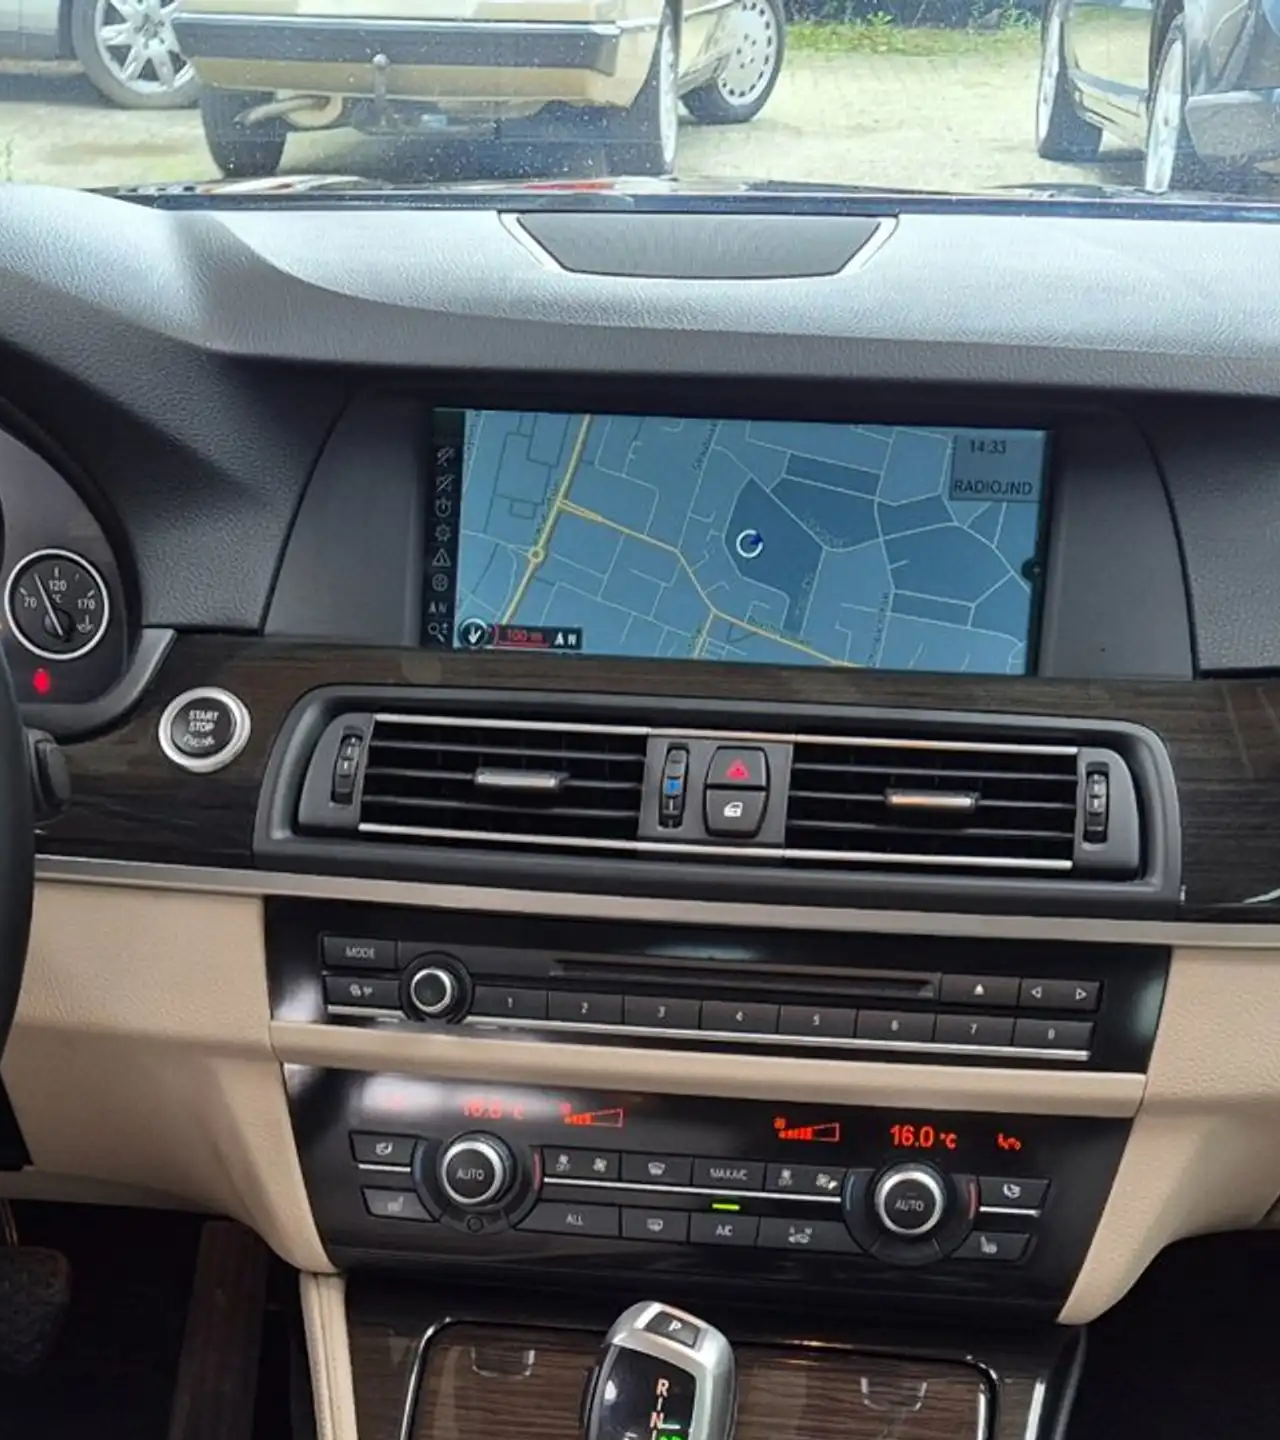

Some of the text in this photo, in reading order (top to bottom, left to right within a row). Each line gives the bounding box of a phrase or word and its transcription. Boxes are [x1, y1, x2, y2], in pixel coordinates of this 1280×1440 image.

[188, 709, 219, 721] START
[189, 721, 216, 732] STOP
[345, 946, 376, 960] MODE
[506, 997, 513, 1008] 1
[580, 1002, 588, 1014] 2
[658, 1007, 665, 1018] 3
[736, 1010, 744, 1021] 4
[813, 1014, 820, 1026] 5
[891, 1019, 899, 1031] 6
[970, 1023, 978, 1035] 7
[1047, 1028, 1055, 1039] 8
[889, 1124, 935, 1148] 16.0
[456, 1168, 485, 1181] AUTO
[894, 1198, 925, 1212] AUTO
[668, 1321, 682, 1332] P
[656, 1378, 670, 1397] R
[650, 1411, 665, 1429] N
